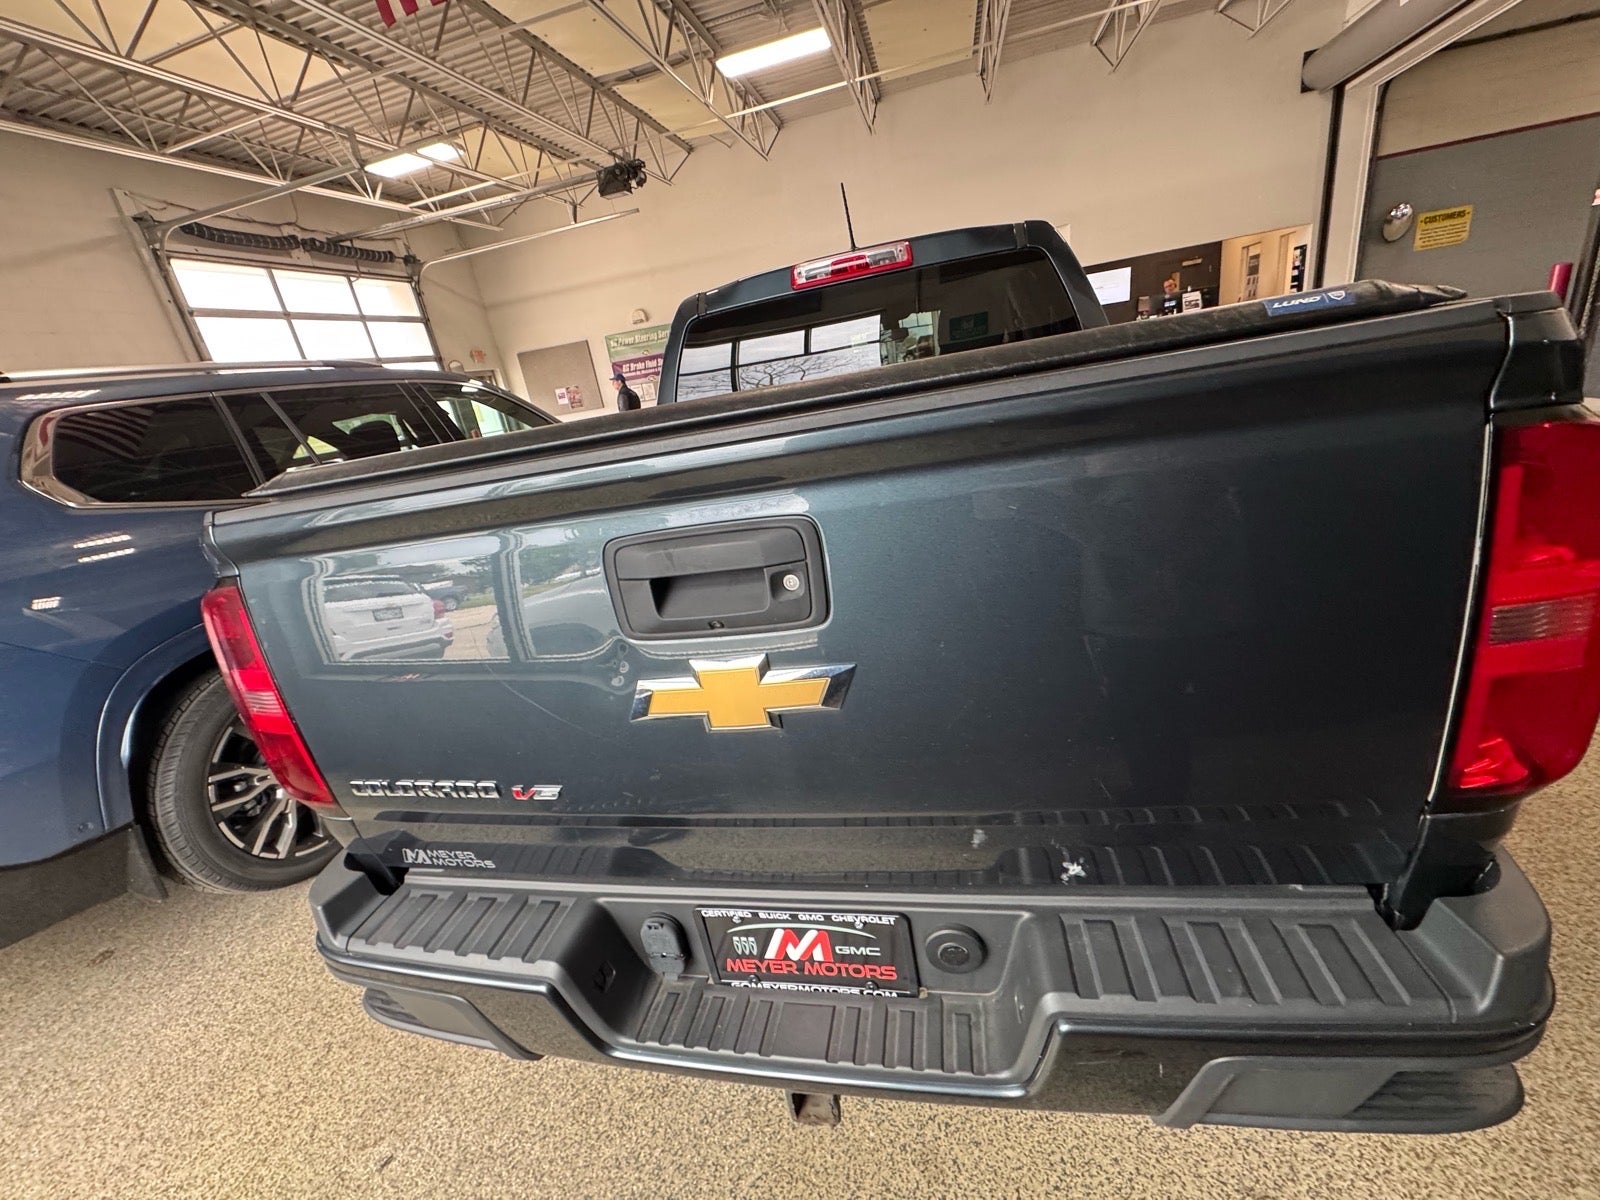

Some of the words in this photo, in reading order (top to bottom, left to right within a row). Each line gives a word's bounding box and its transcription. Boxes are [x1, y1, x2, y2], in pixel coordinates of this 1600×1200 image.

[1424, 209, 1467, 225] CUSTOMERS
[1272, 295, 1322, 308] LUND
[634, 331, 658, 344] Steering
[350, 779, 501, 799] COLORADO
[511, 784, 563, 800] V6
[427, 849, 477, 860] MEYER
[432, 857, 497, 869] MOTORS
[701, 909, 752, 918] CERTIFIED
[758, 912, 792, 921] BUICK
[797, 913, 825, 922] GMC
[831, 915, 897, 926] CHEVROLET
[835, 945, 881, 956] GMC
[726, 958, 799, 975] MEYER
[804, 961, 898, 980] MOTORS
[731, 981, 898, 998] GOMEYERMOTORSCOM
